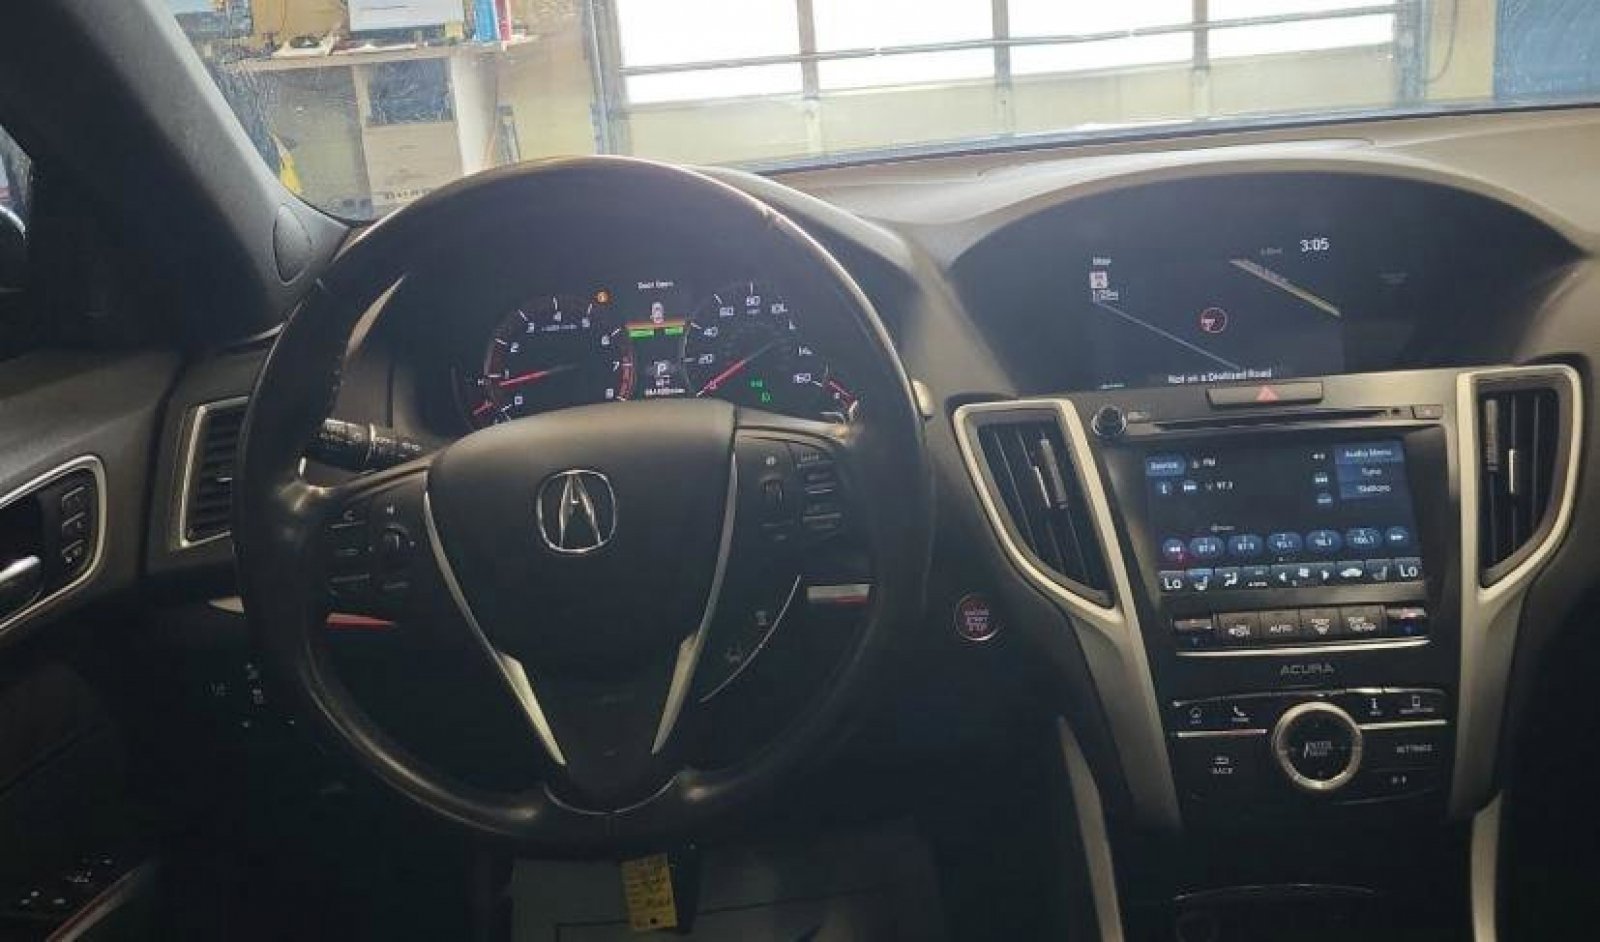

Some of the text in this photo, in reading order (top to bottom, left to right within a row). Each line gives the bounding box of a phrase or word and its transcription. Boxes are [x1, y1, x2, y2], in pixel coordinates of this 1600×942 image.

[1300, 238, 1330, 252] 3:05
[526, 322, 535, 333] 3
[510, 341, 520, 353] 2
[657, 362, 667, 376] P
[1167, 374, 1184, 384] Not
[514, 395, 524, 405] 0
[1398, 564, 1419, 577] Lo
[1280, 664, 1335, 676] ACURA
